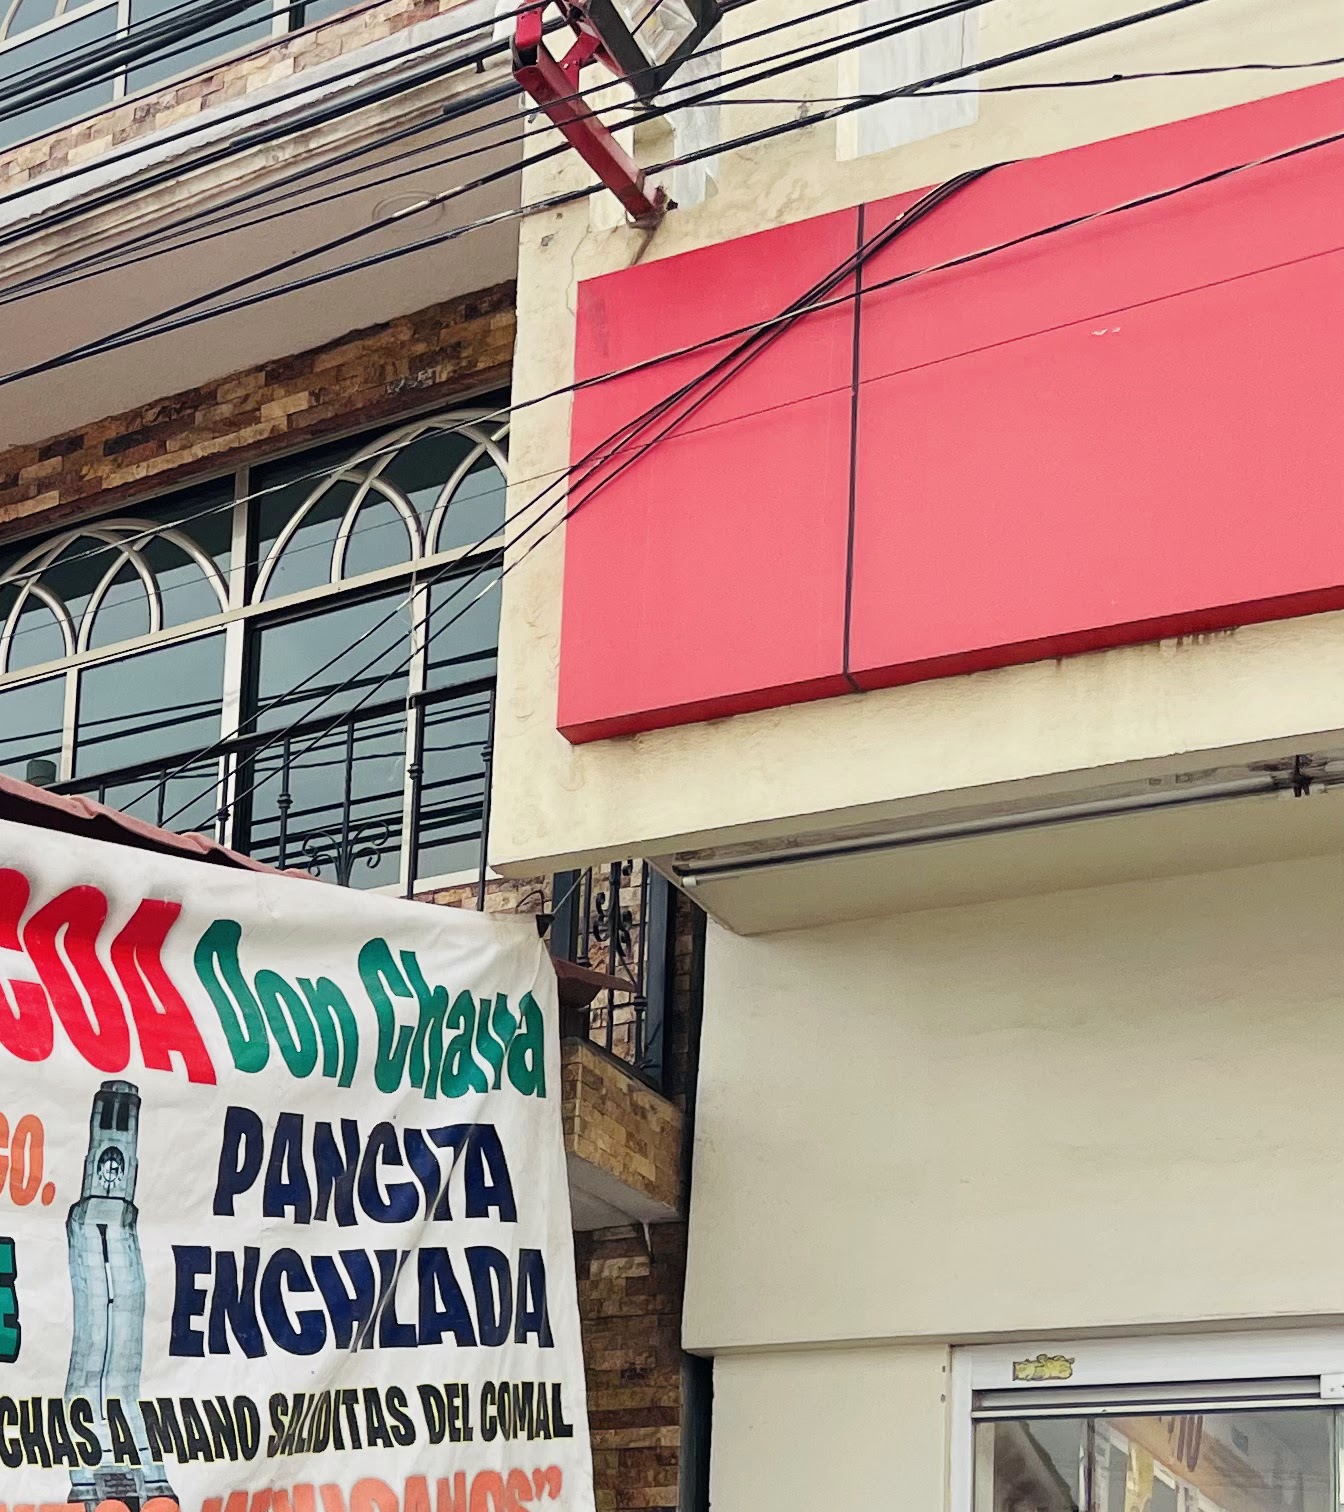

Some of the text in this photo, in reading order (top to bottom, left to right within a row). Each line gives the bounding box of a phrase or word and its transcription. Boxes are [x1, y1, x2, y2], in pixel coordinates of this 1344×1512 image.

[194, 919, 359, 1088] Don
[212, 1105, 518, 1228] PANCITA
[106, 1398, 142, 1466] A
[138, 1394, 261, 1464] MANO
[416, 1382, 474, 1445] DEL
[479, 1379, 574, 1443] COMAL
